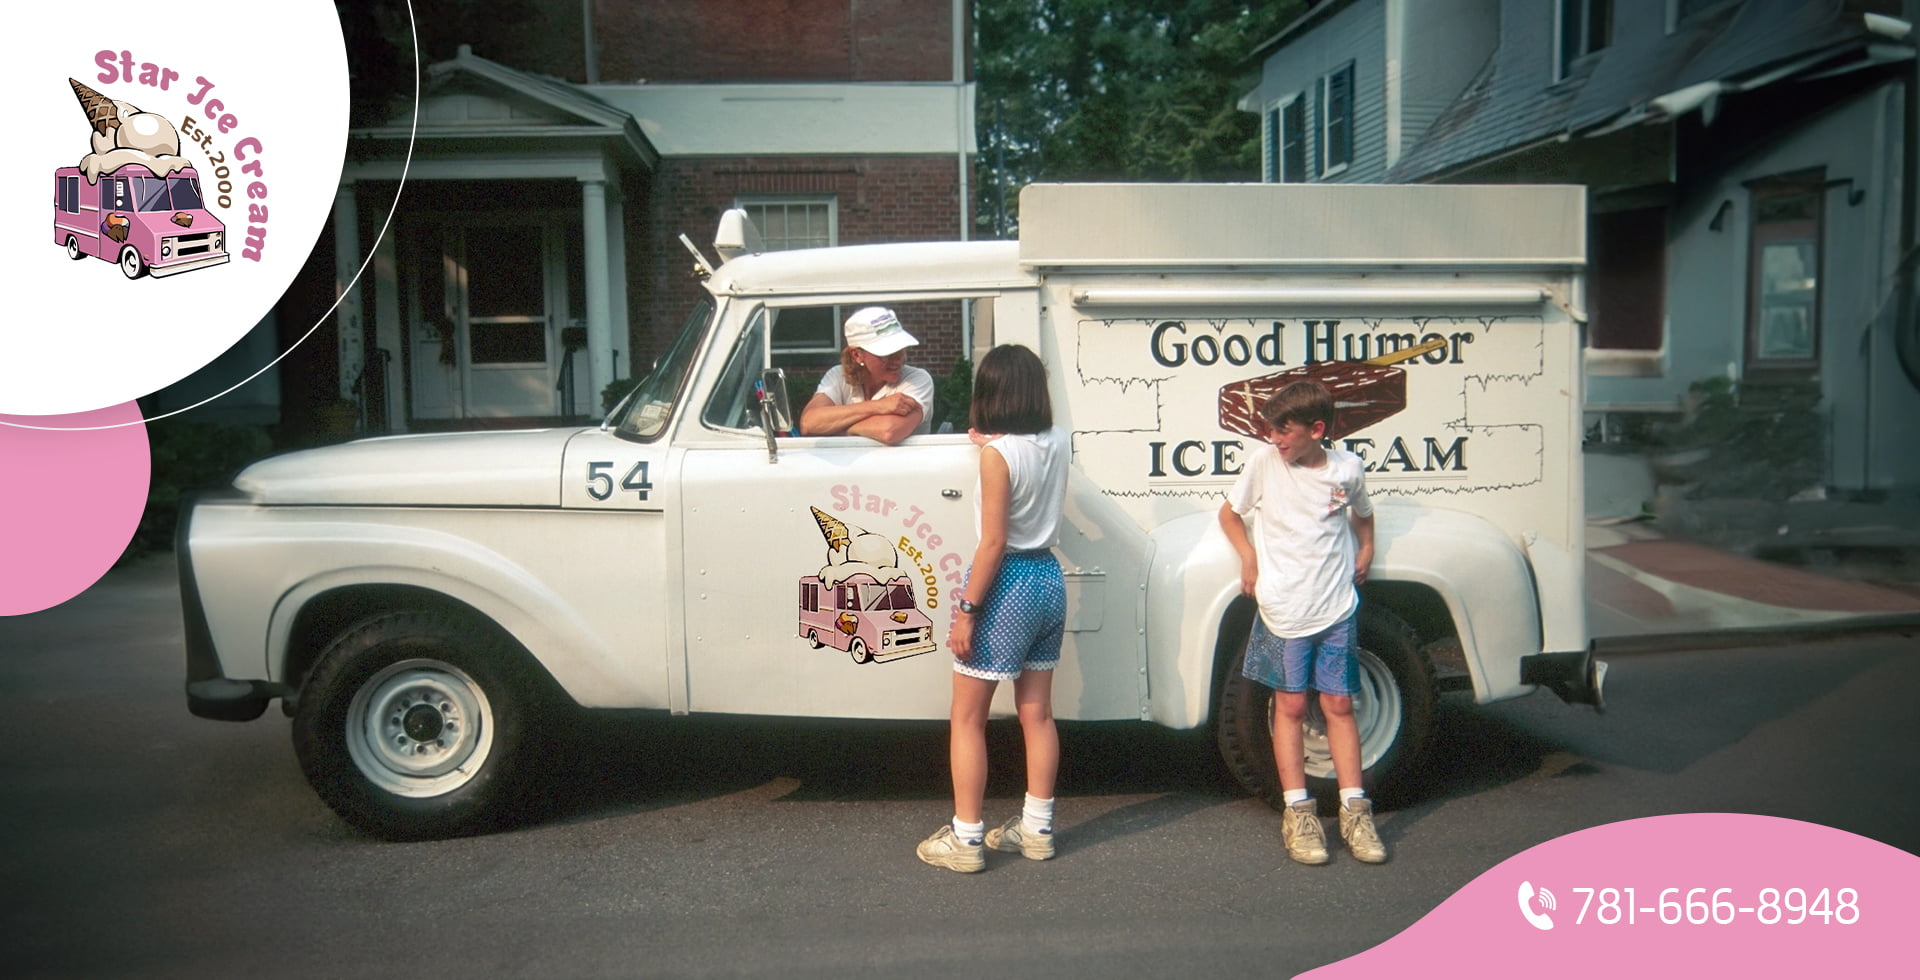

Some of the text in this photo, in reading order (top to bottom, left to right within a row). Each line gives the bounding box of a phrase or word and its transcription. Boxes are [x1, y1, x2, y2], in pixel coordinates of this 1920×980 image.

[1150, 320, 1474, 368] Good Humor
[1148, 436, 1468, 477] ICE EAM
[586, 461, 653, 501] 54
[830, 484, 897, 517] Star
[898, 536, 938, 609] Est.2000
